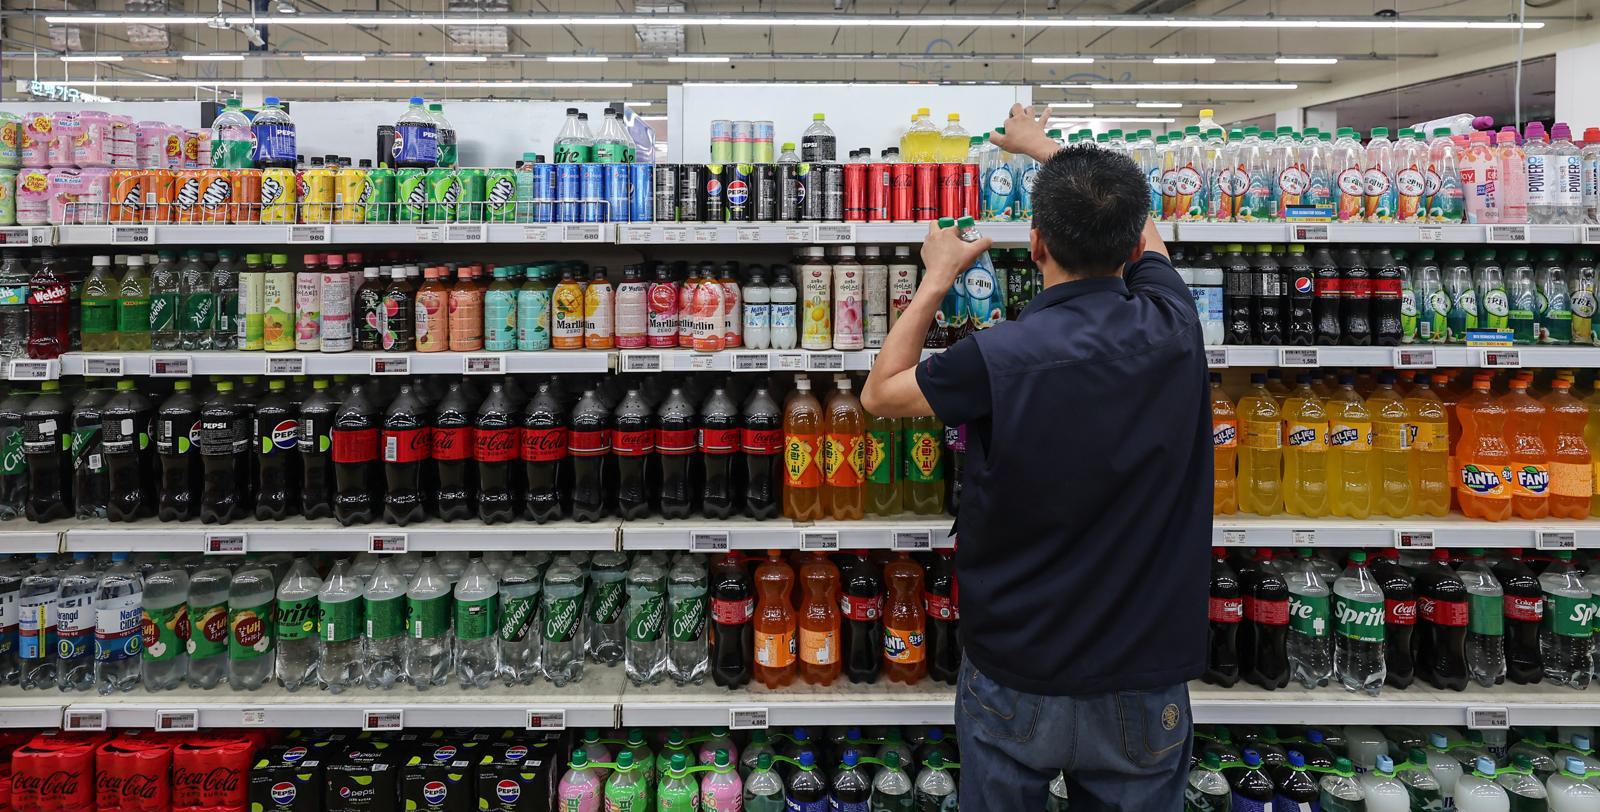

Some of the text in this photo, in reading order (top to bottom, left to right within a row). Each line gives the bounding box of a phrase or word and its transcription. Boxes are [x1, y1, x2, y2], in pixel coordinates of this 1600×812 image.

[31, 80, 80, 103] 편백가구
[1399, 177, 1424, 190] 트레비
[1528, 164, 1545, 193] POWER
[1569, 164, 1581, 193] POWER
[967, 278, 992, 290] 트레비
[1289, 429, 1316, 445] 써니텐
[1331, 429, 1358, 445] 써니텐
[1461, 469, 1500, 486] FANTA
[120, 607, 142, 621] Naran
[545, 596, 577, 638] Chilsung
[674, 597, 703, 637] Chilsung
[559, 612, 574, 634] Cider
[567, 617, 581, 638] ZERO
[884, 635, 906, 651] ANTA
[272, 788, 296, 797] PEPSI
[351, 787, 375, 798] pepsi
[424, 787, 447, 796] PEPSI
[497, 787, 519, 795] PEPSI
